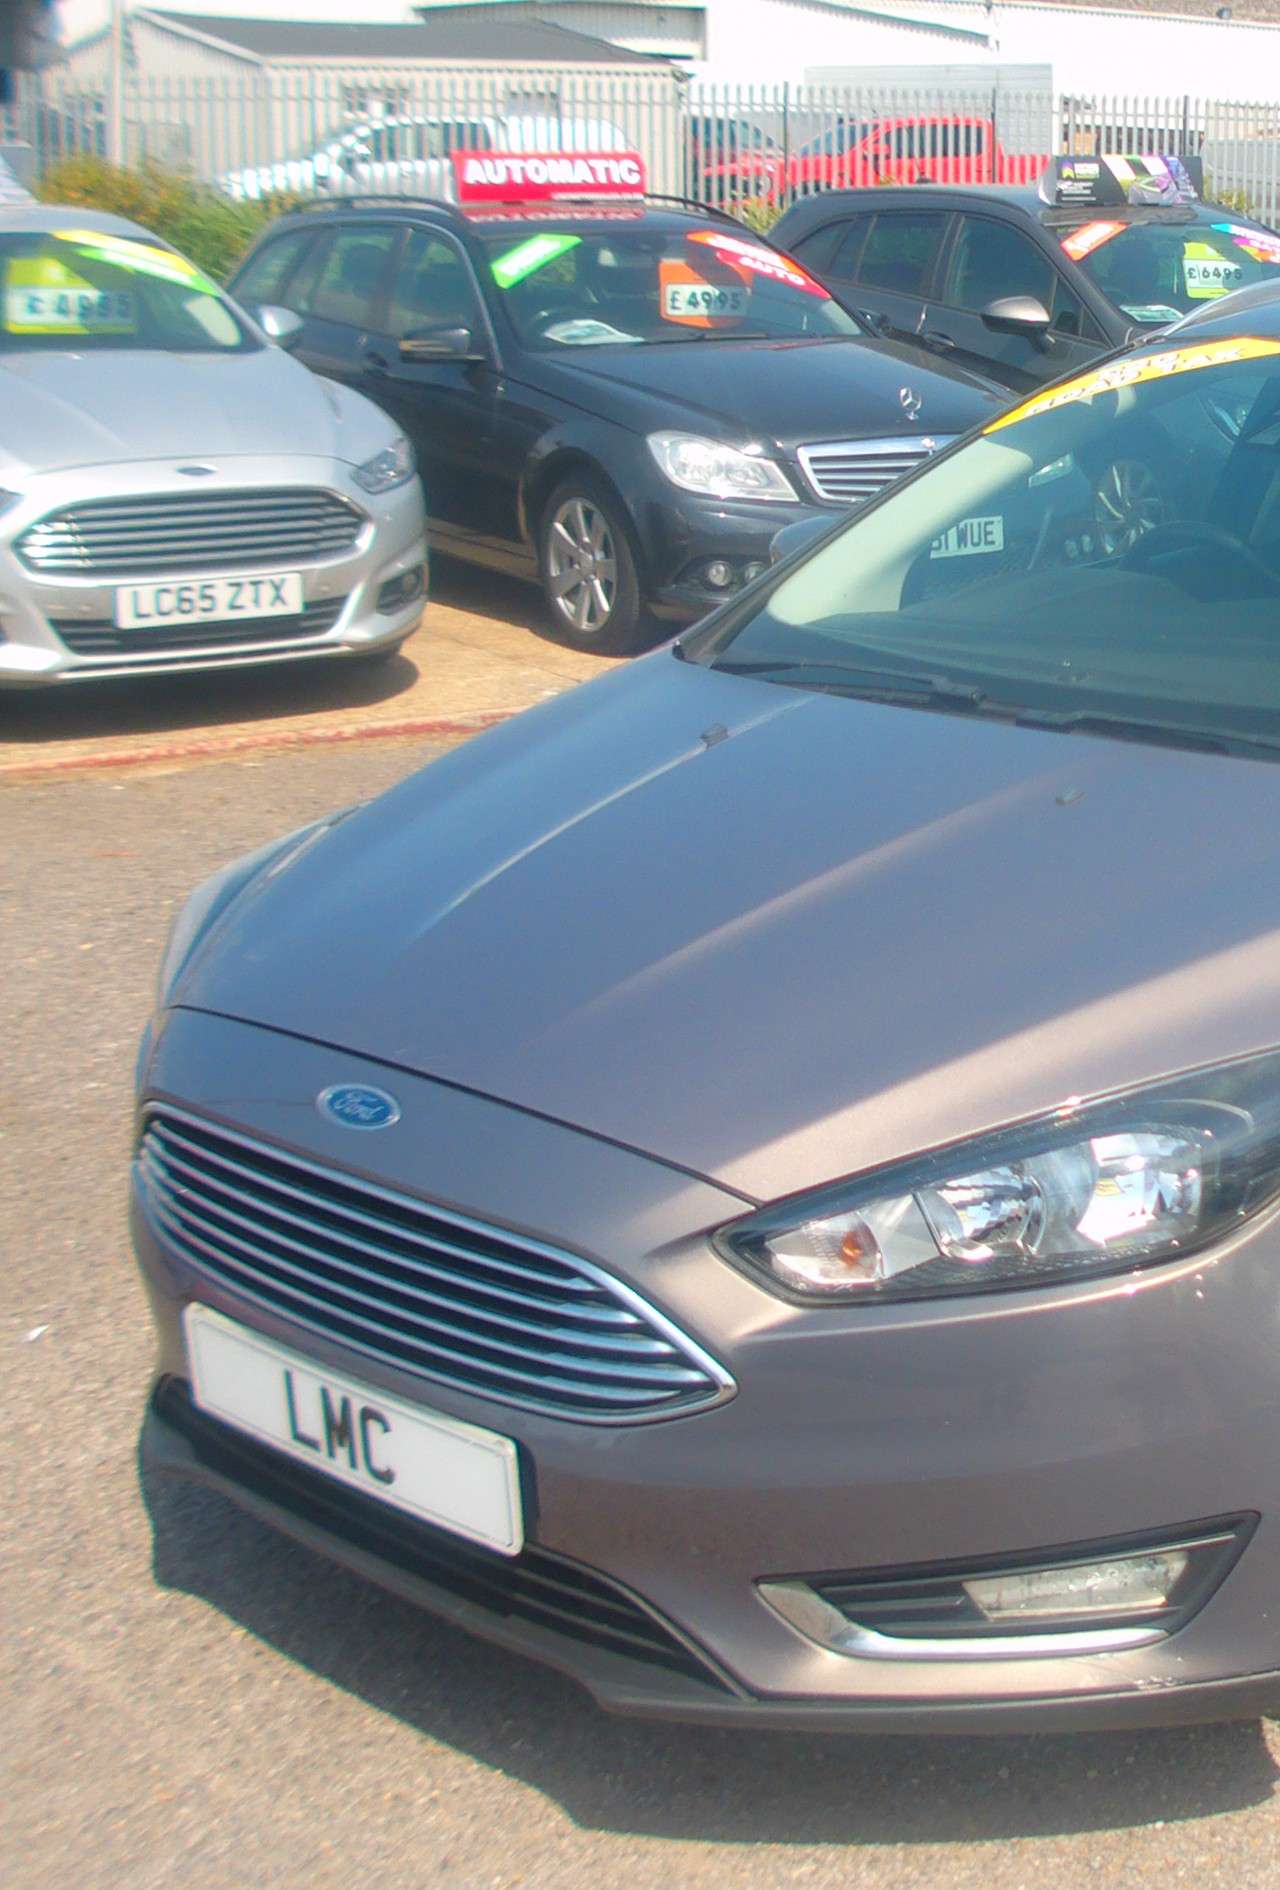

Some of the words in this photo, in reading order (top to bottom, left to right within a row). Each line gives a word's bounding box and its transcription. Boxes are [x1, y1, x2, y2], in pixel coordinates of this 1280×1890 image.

[464, 158, 640, 185] AUTOMATIC
[132, 582, 218, 619] LC65
[227, 577, 288, 611] ZTX
[282, 1368, 396, 1486] LMC
